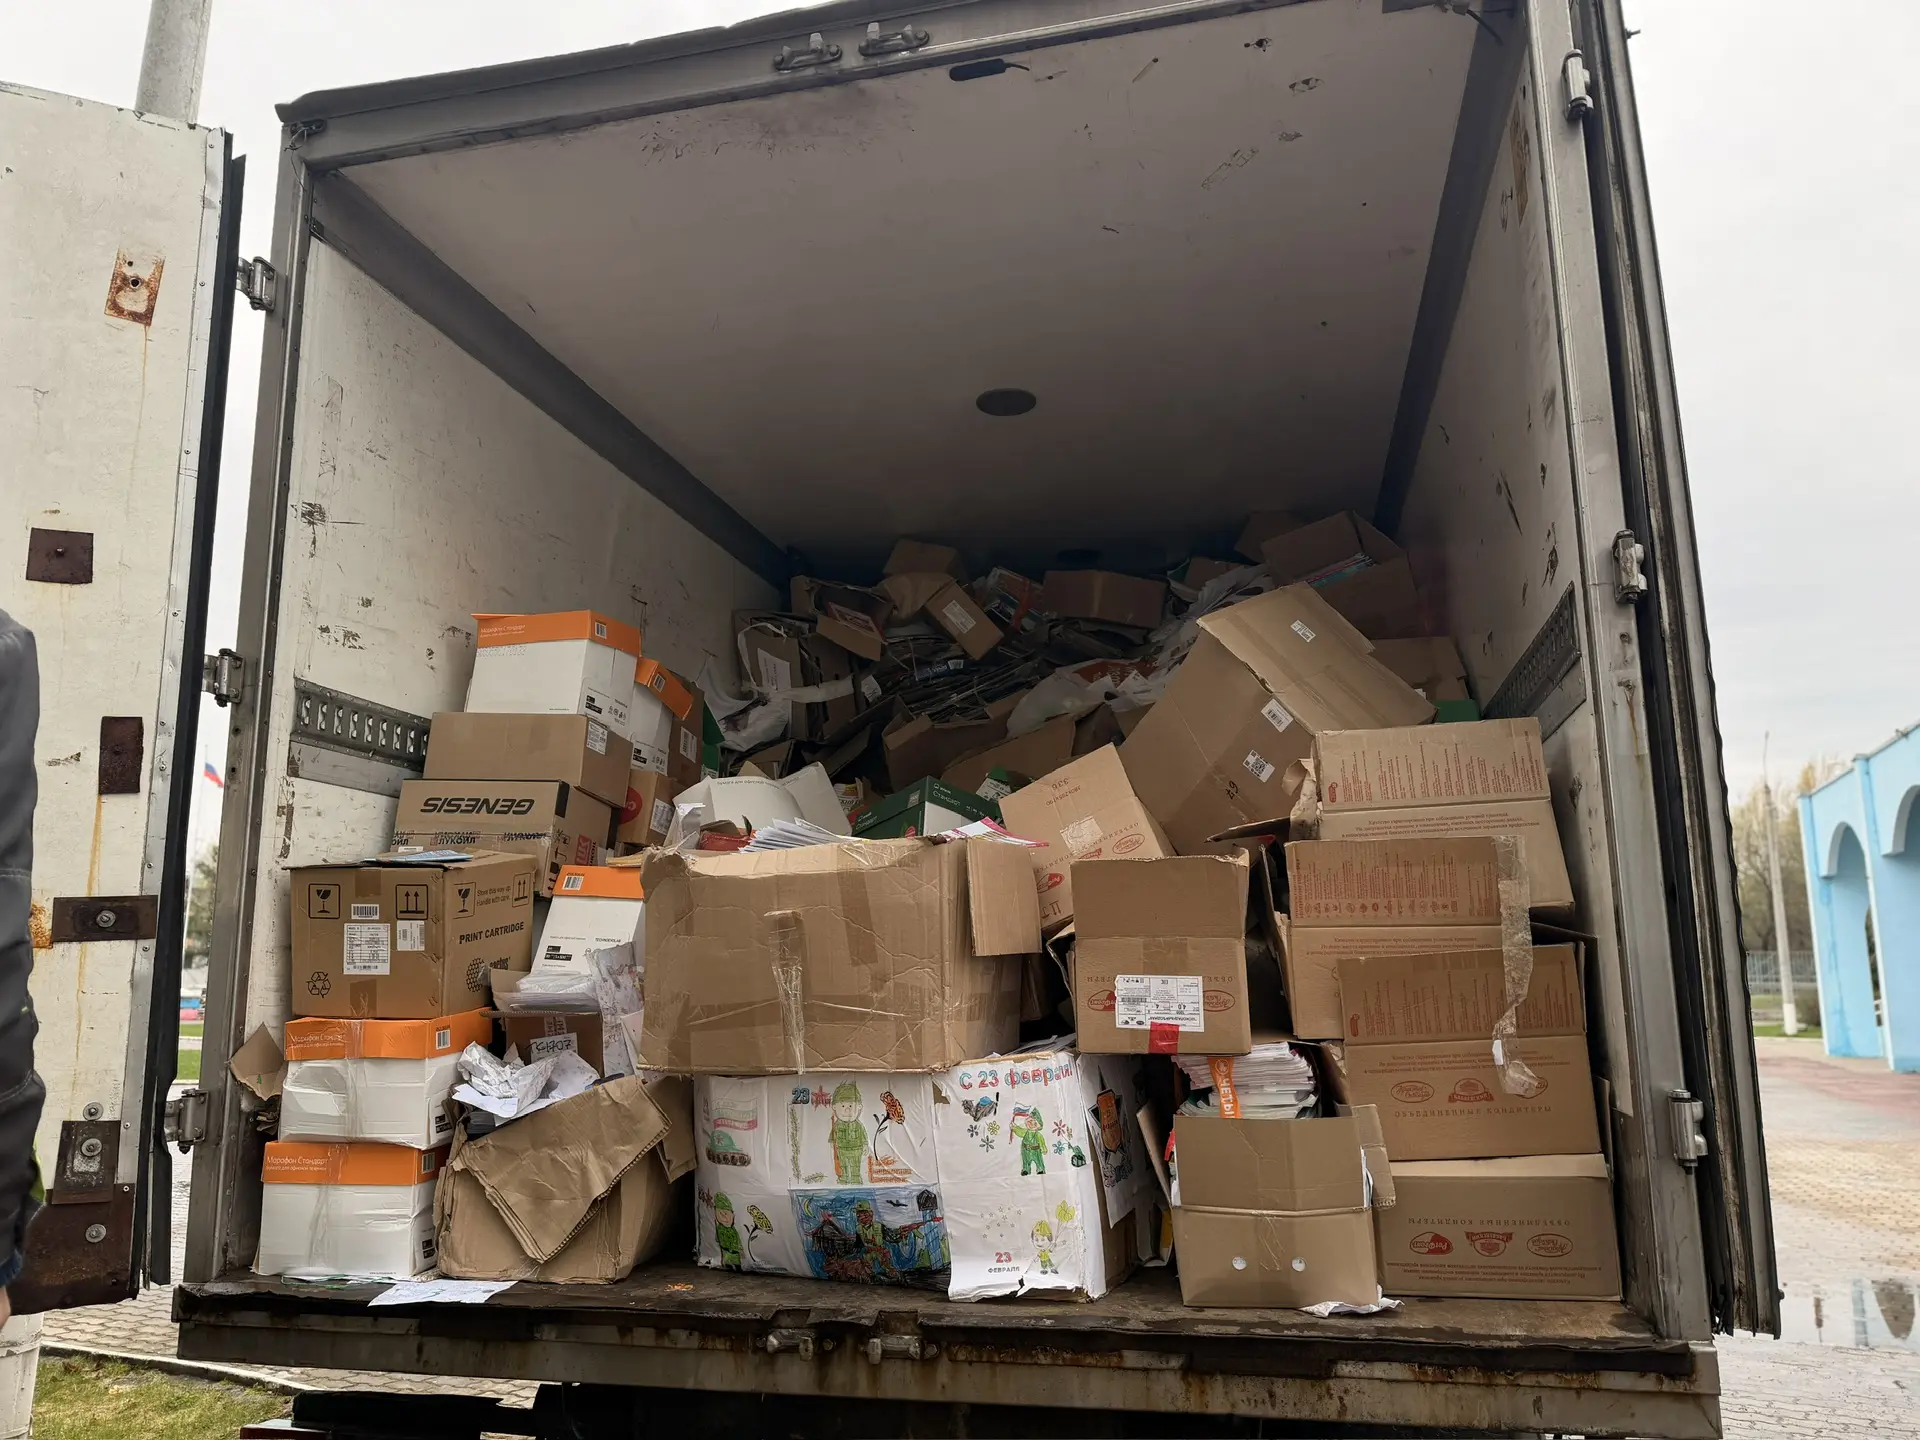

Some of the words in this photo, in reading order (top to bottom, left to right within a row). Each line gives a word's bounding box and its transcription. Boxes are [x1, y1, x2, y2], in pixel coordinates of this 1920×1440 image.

[420, 797, 535, 815] GENESIS
[438, 836, 476, 845] ЛУКОЙЛ
[459, 930, 483, 944] PRINT
[484, 921, 524, 938] CARTRIDGE
[959, 1072, 973, 1090] С
[977, 1068, 1000, 1089] 23
[791, 1086, 810, 1105] 23
[1219, 1077, 1236, 1118] ЧЕТЫ
[1394, 1108, 1482, 1118] ОБЪЕДИНЕННЫЕ
[1486, 1105, 1552, 1115] КОНДИТЕРЫ
[267, 1155, 297, 1165] Марафон
[297, 1155, 328, 1165] Стандарт
[1408, 1216, 1473, 1226] КОНДИТЕРЫ
[1479, 1216, 1571, 1227] ОБЪЕДИНЕННЫЕ
[994, 1251, 1012, 1264] 23
[987, 1266, 1020, 1274] ФЕВРАЛЯ
